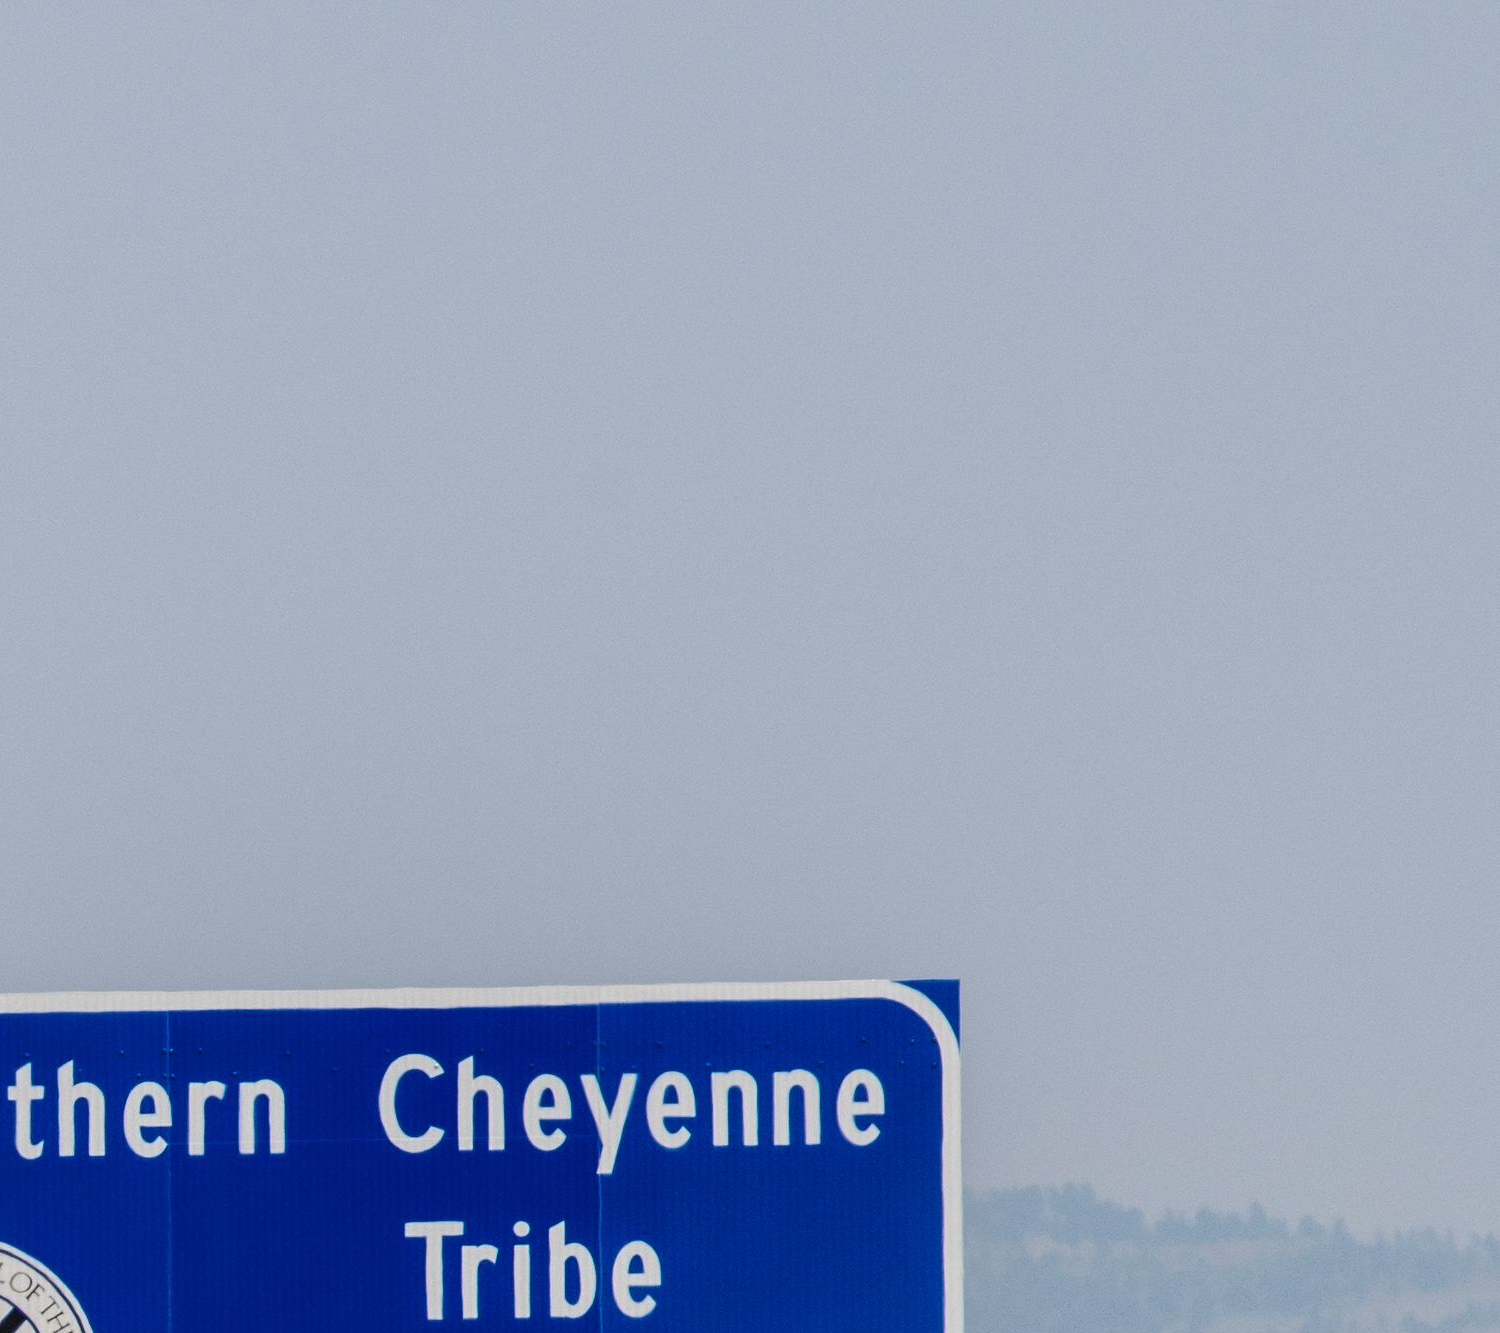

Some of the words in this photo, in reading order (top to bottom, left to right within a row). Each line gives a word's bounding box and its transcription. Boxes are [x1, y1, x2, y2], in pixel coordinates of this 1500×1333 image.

[378, 1053, 886, 1176] Cheyenne
[9, 1272, 46, 1300] OF
[404, 1220, 662, 1321] Tribe
